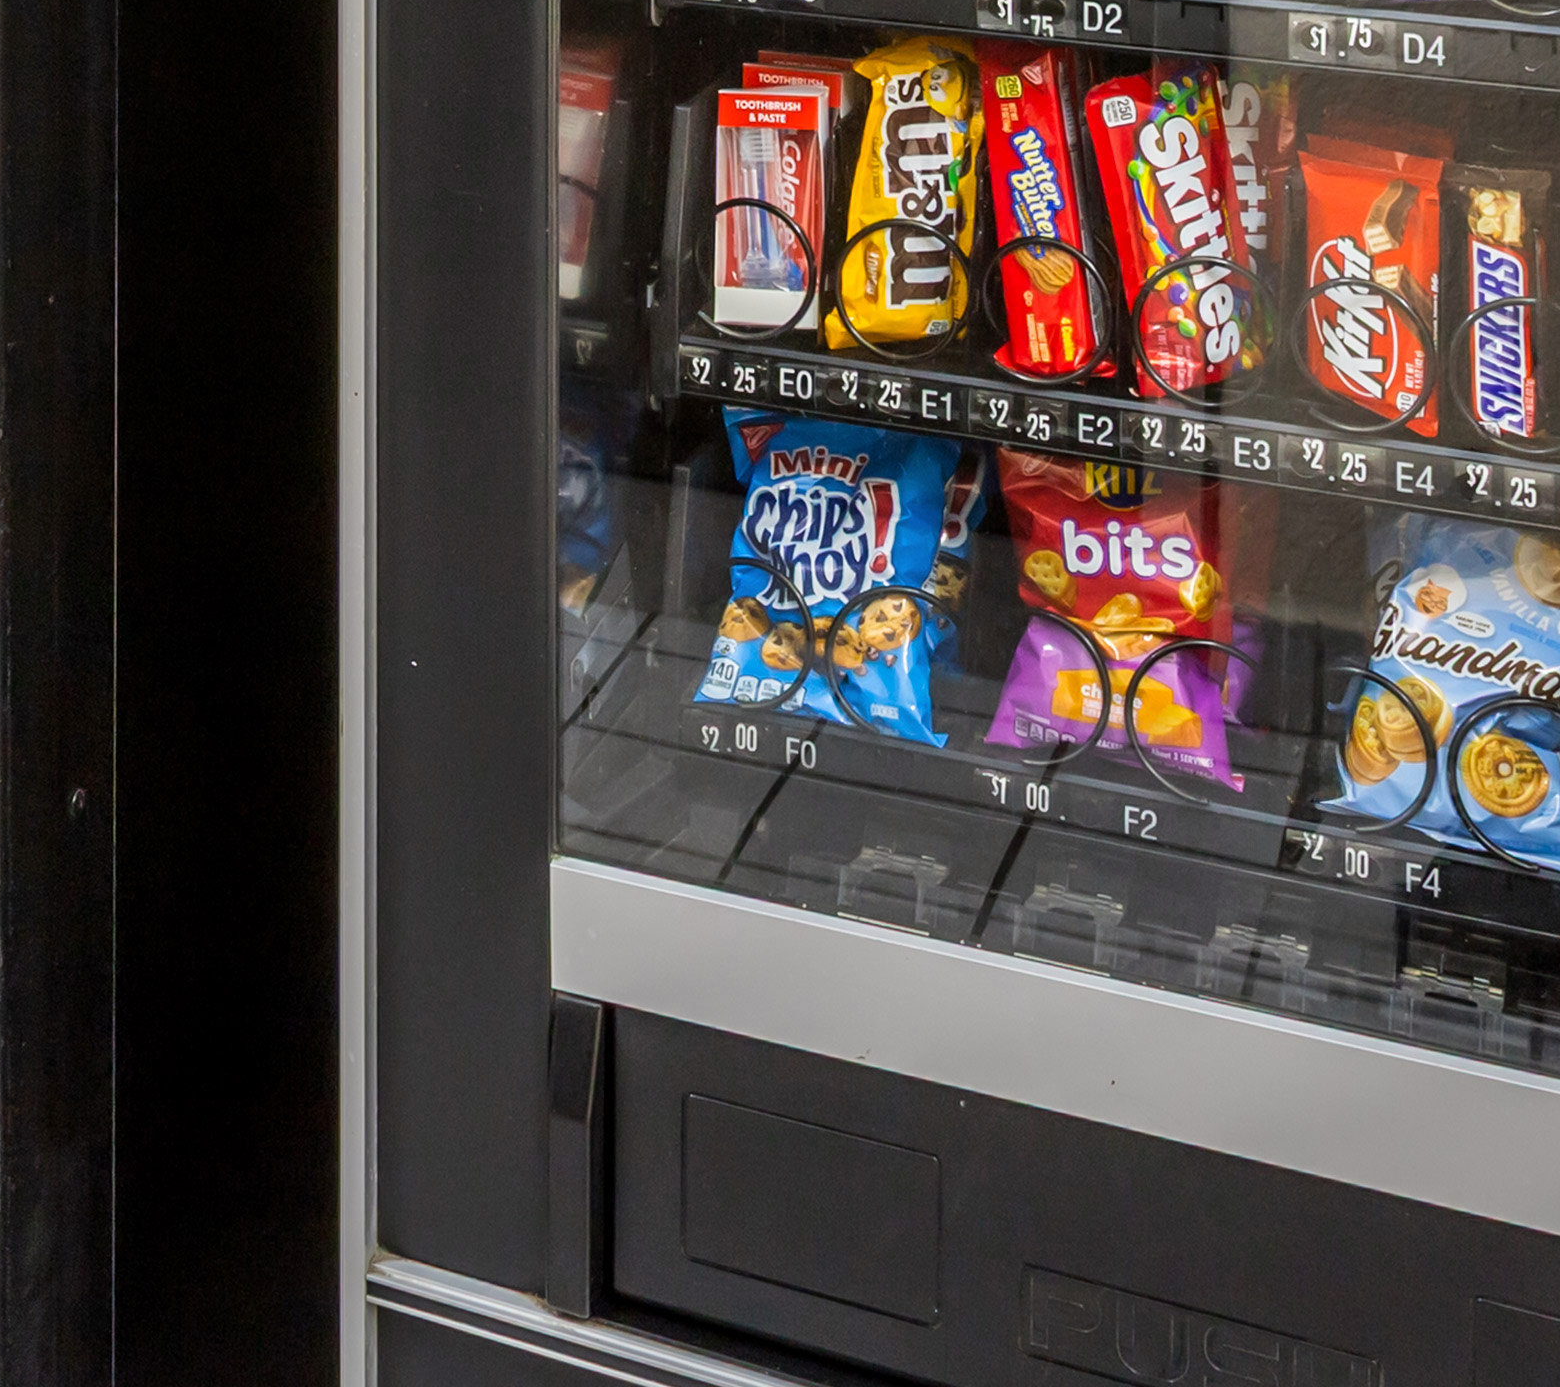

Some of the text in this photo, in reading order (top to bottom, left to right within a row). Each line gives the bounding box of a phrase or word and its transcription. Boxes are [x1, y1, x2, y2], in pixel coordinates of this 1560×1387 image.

[1082, 3, 1122, 33] D2
[1403, 34, 1445, 66] D4
[735, 101, 801, 112] TOOTHBRUSH
[759, 112, 786, 123] PASTE
[1139, 120, 1241, 365] Skittles
[1473, 243, 1526, 437] SNICKERS
[780, 368, 812, 398] E0
[921, 390, 953, 421] E1
[1078, 414, 1113, 446] E2
[770, 447, 871, 486] Mini
[1234, 438, 1271, 469] E3
[1395, 463, 1434, 496] E4
[1060, 520, 1194, 579] bits
[786, 738, 816, 769] F0
[1124, 806, 1159, 840] F2
[1405, 863, 1442, 899] F4
